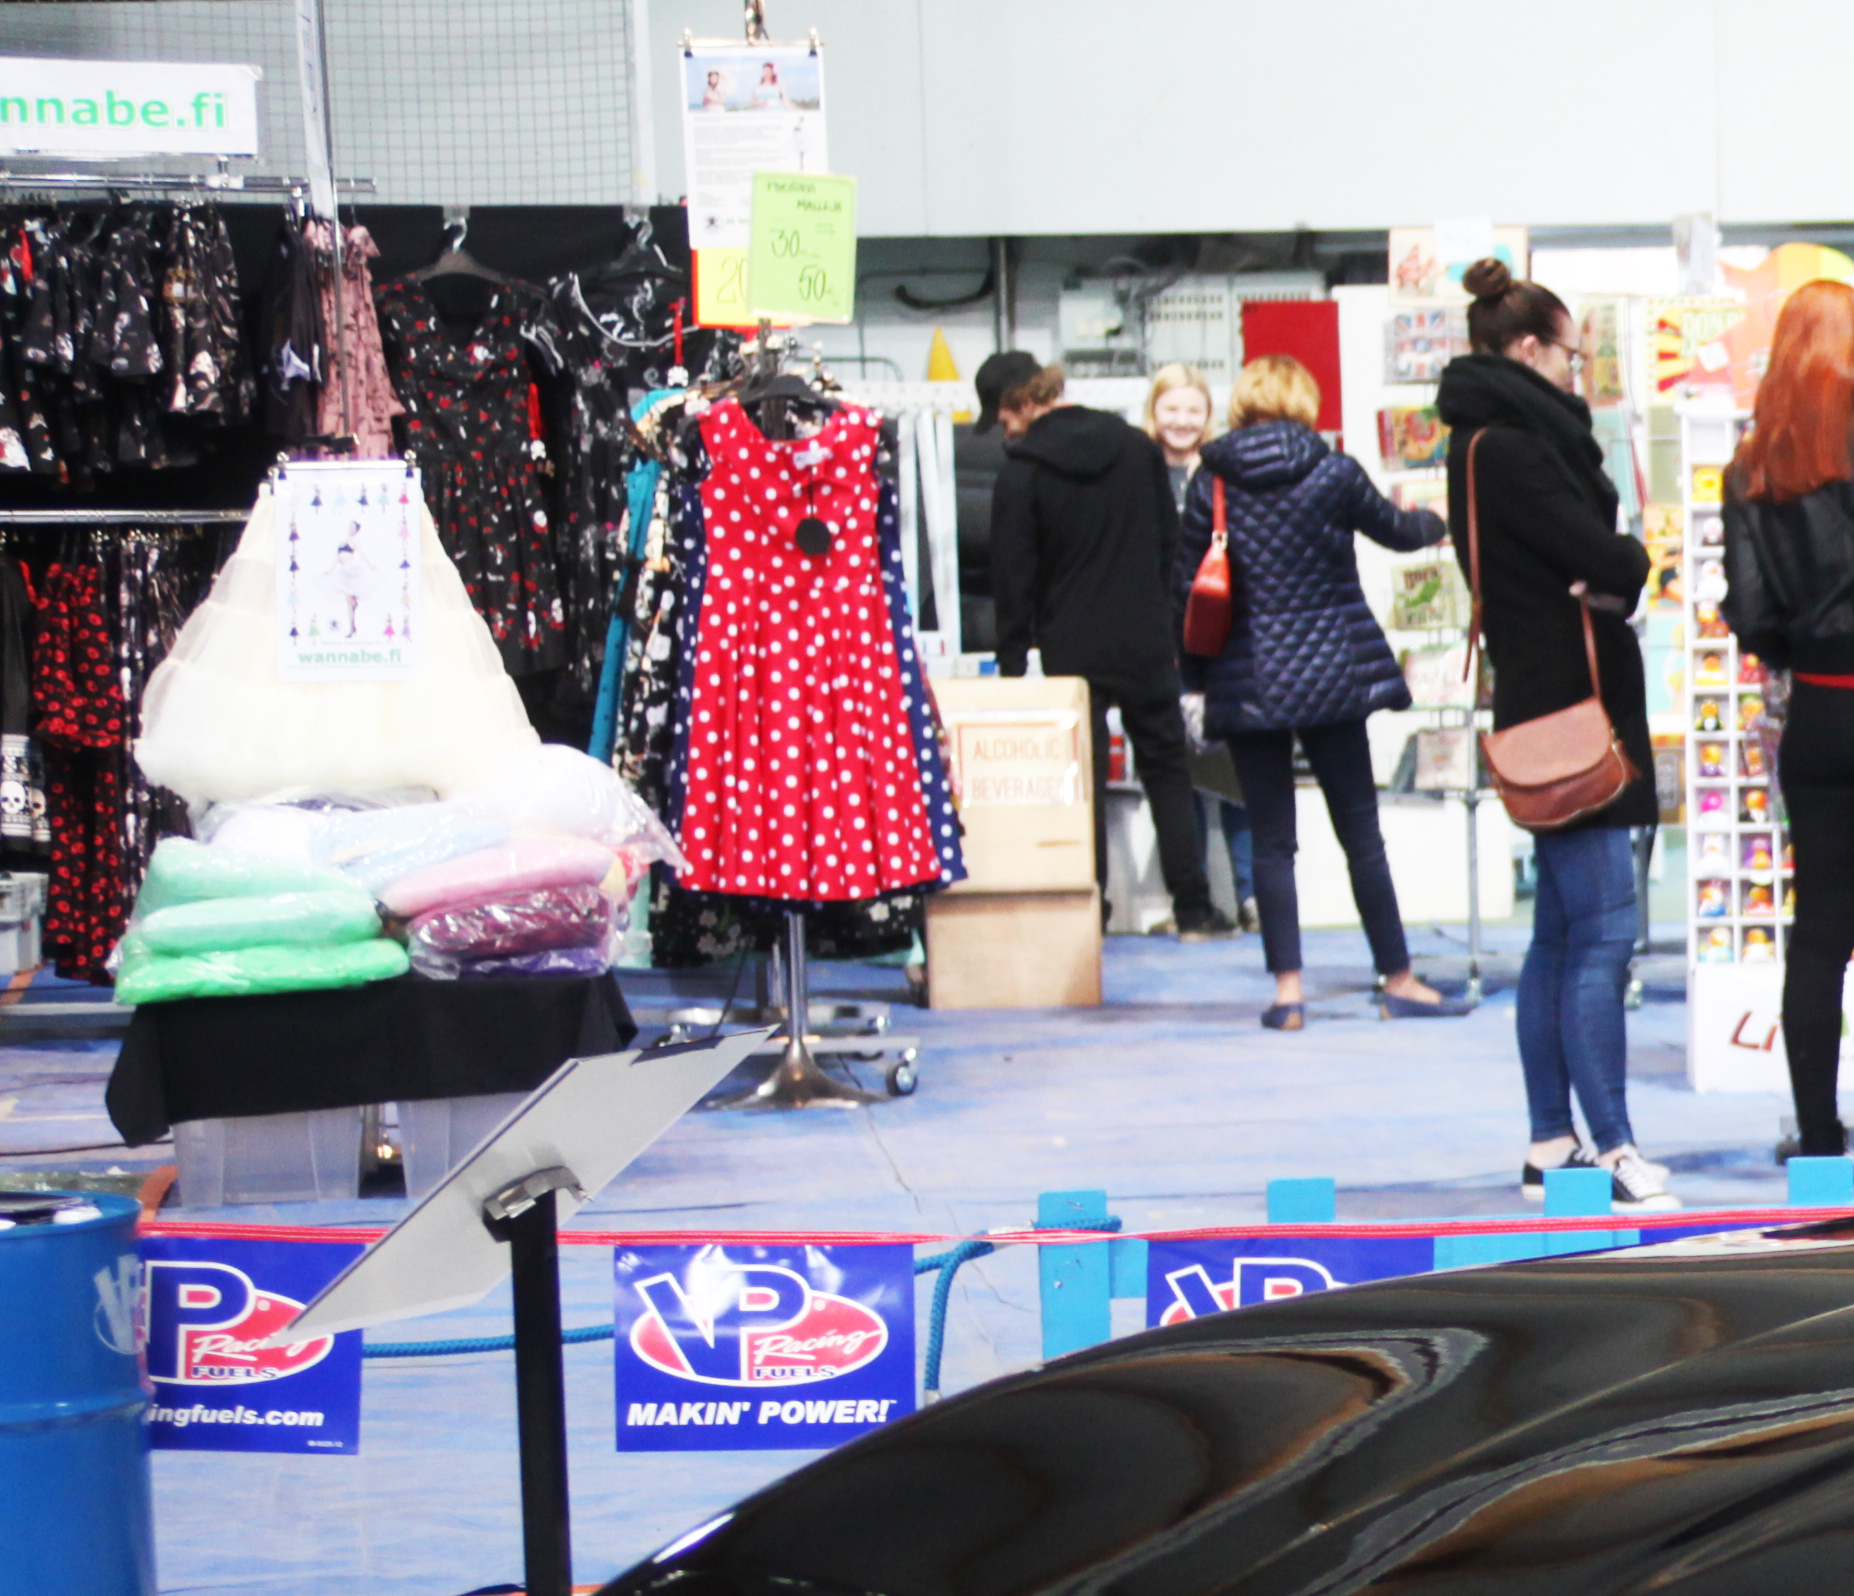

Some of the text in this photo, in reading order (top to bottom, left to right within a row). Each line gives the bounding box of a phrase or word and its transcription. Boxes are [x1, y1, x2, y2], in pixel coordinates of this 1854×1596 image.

[0, 90, 226, 128] nnabe.fi
[298, 648, 402, 664] wannabe.fi
[973, 738, 1062, 761] ALCOHOLIC
[753, 1329, 884, 1365] Racing
[191, 1365, 279, 1380] FUELS
[753, 1365, 838, 1380] FUELS
[143, 1404, 325, 1428] ingfuels.com
[627, 1400, 890, 1426] MAKIN' POWER!
